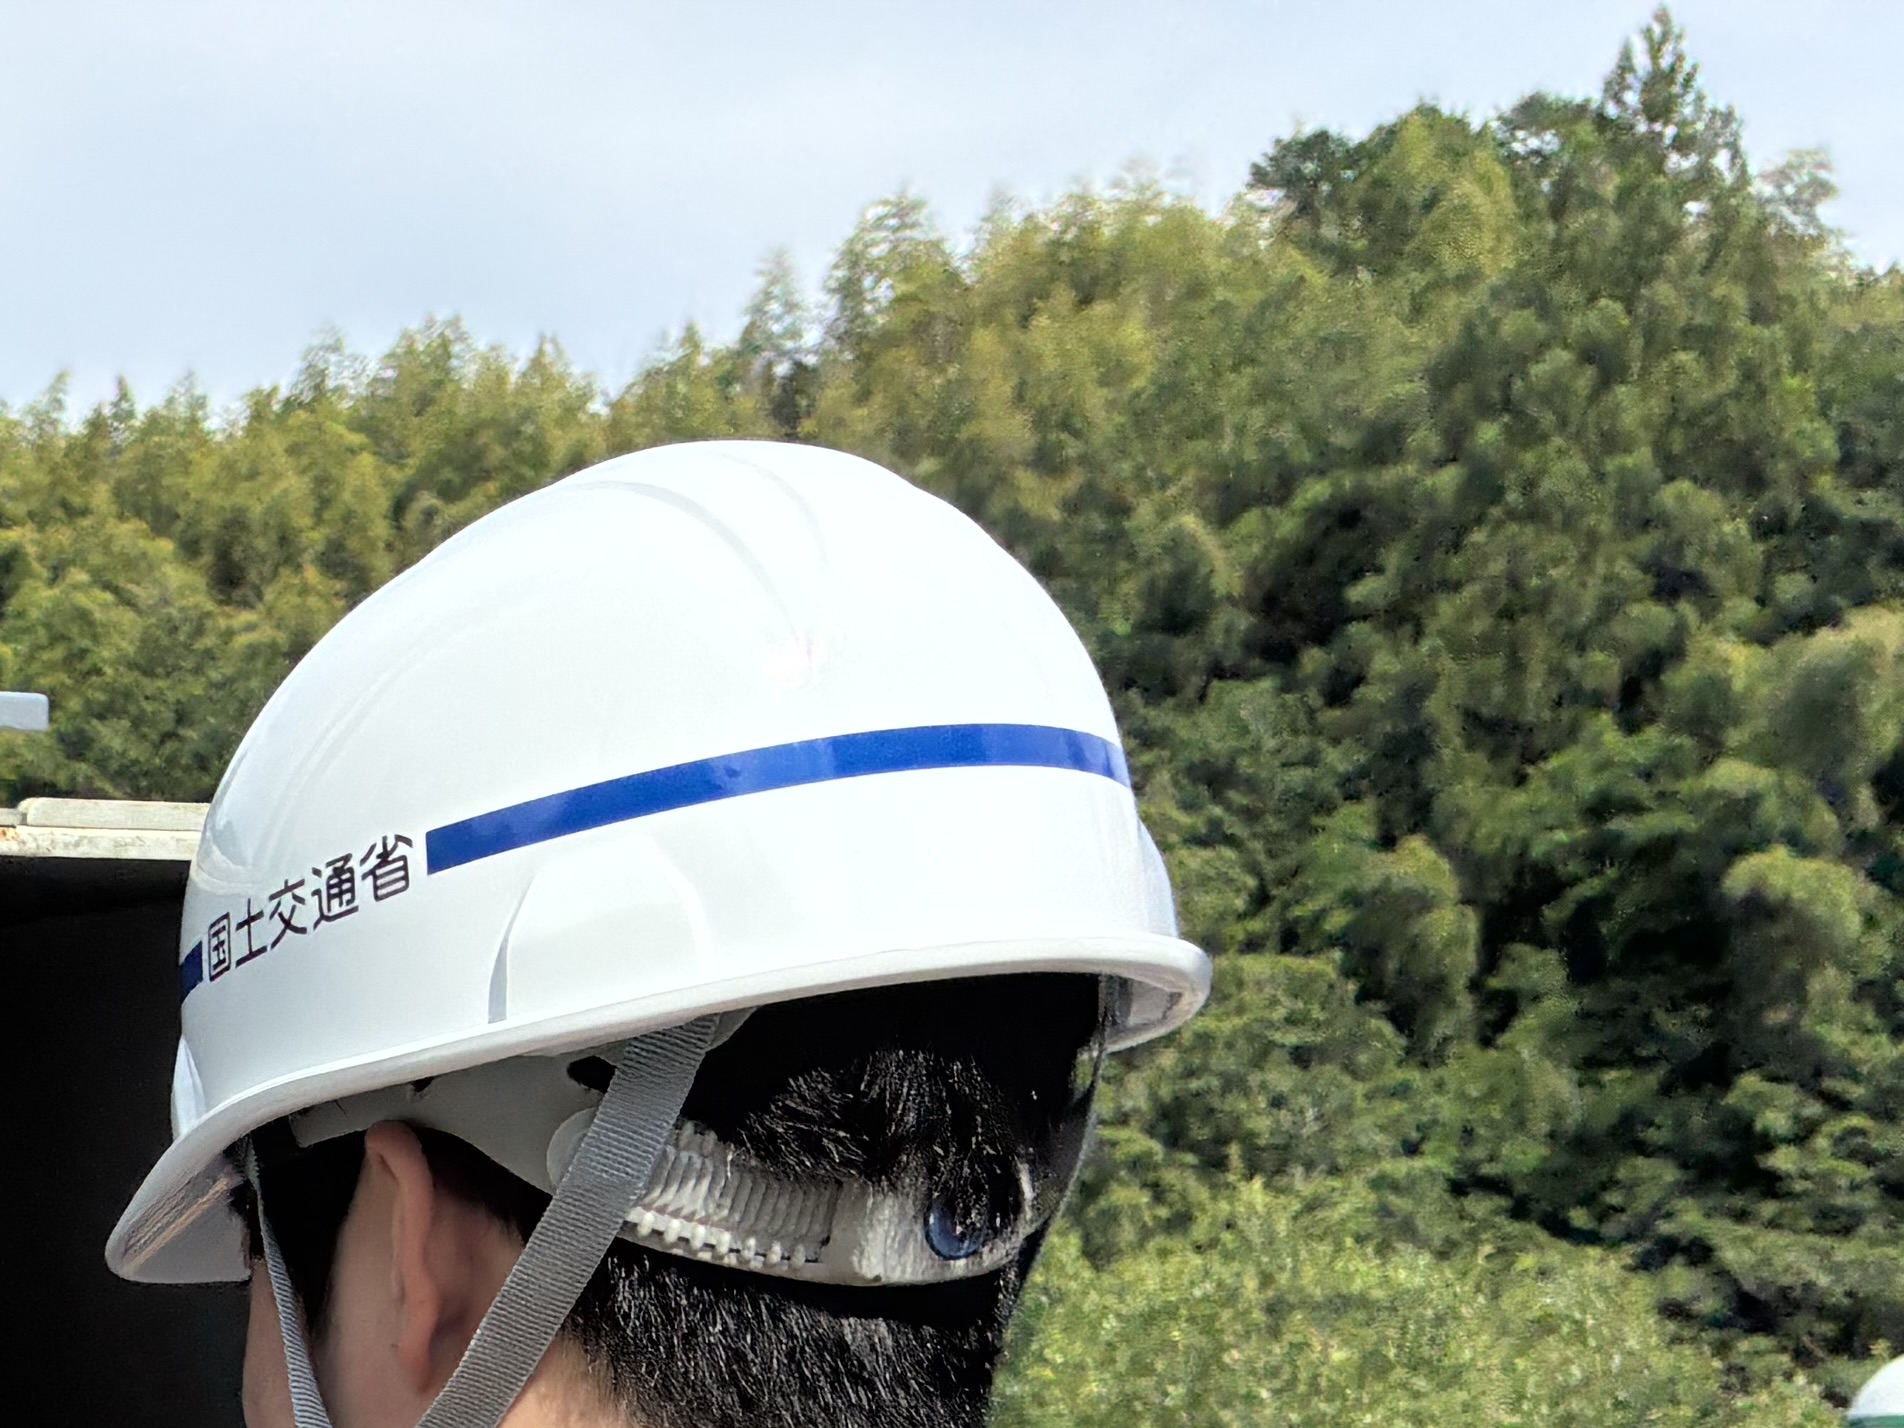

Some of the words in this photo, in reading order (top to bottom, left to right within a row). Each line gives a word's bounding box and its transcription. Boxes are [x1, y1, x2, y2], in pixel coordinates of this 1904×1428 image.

[207, 833, 414, 984] 国土交通省
